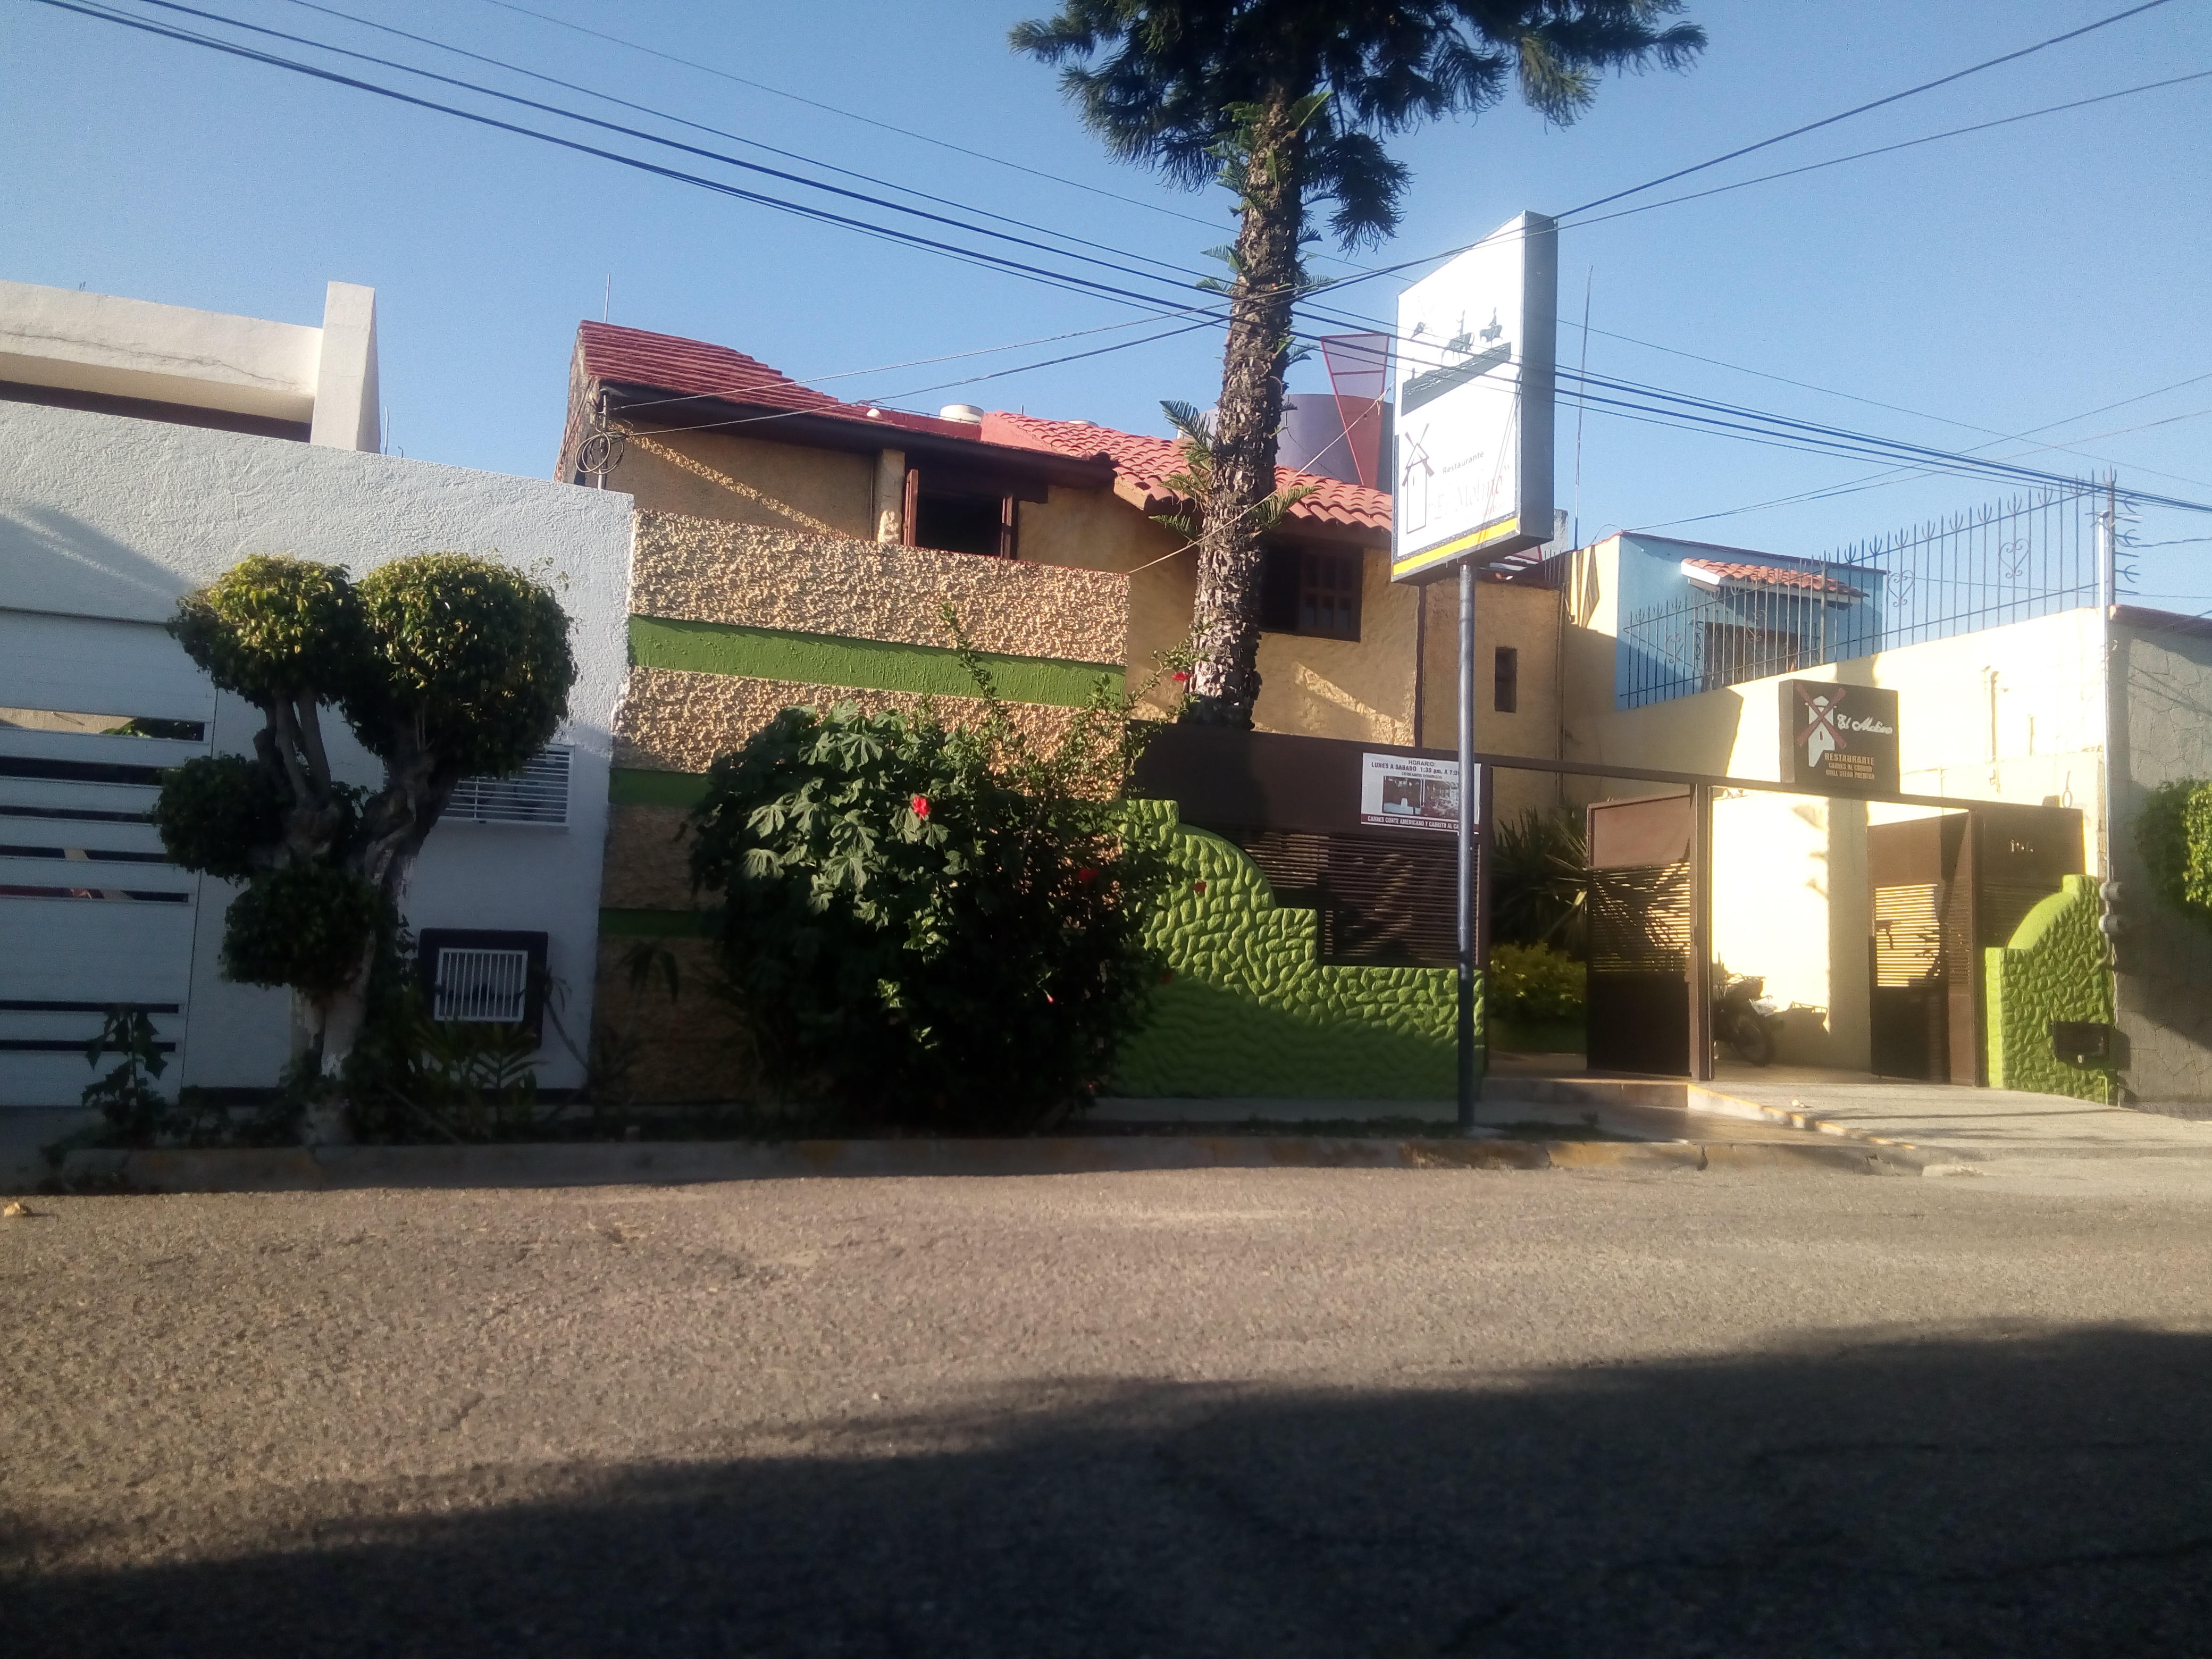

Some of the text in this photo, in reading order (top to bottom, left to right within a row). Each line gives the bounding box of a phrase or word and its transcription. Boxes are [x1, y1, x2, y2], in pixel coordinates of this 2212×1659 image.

[1443, 451, 1484, 474] Restaurante
[1408, 759, 1436, 767] HORARIO:
[1824, 752, 1875, 766] RESTAURANTE
